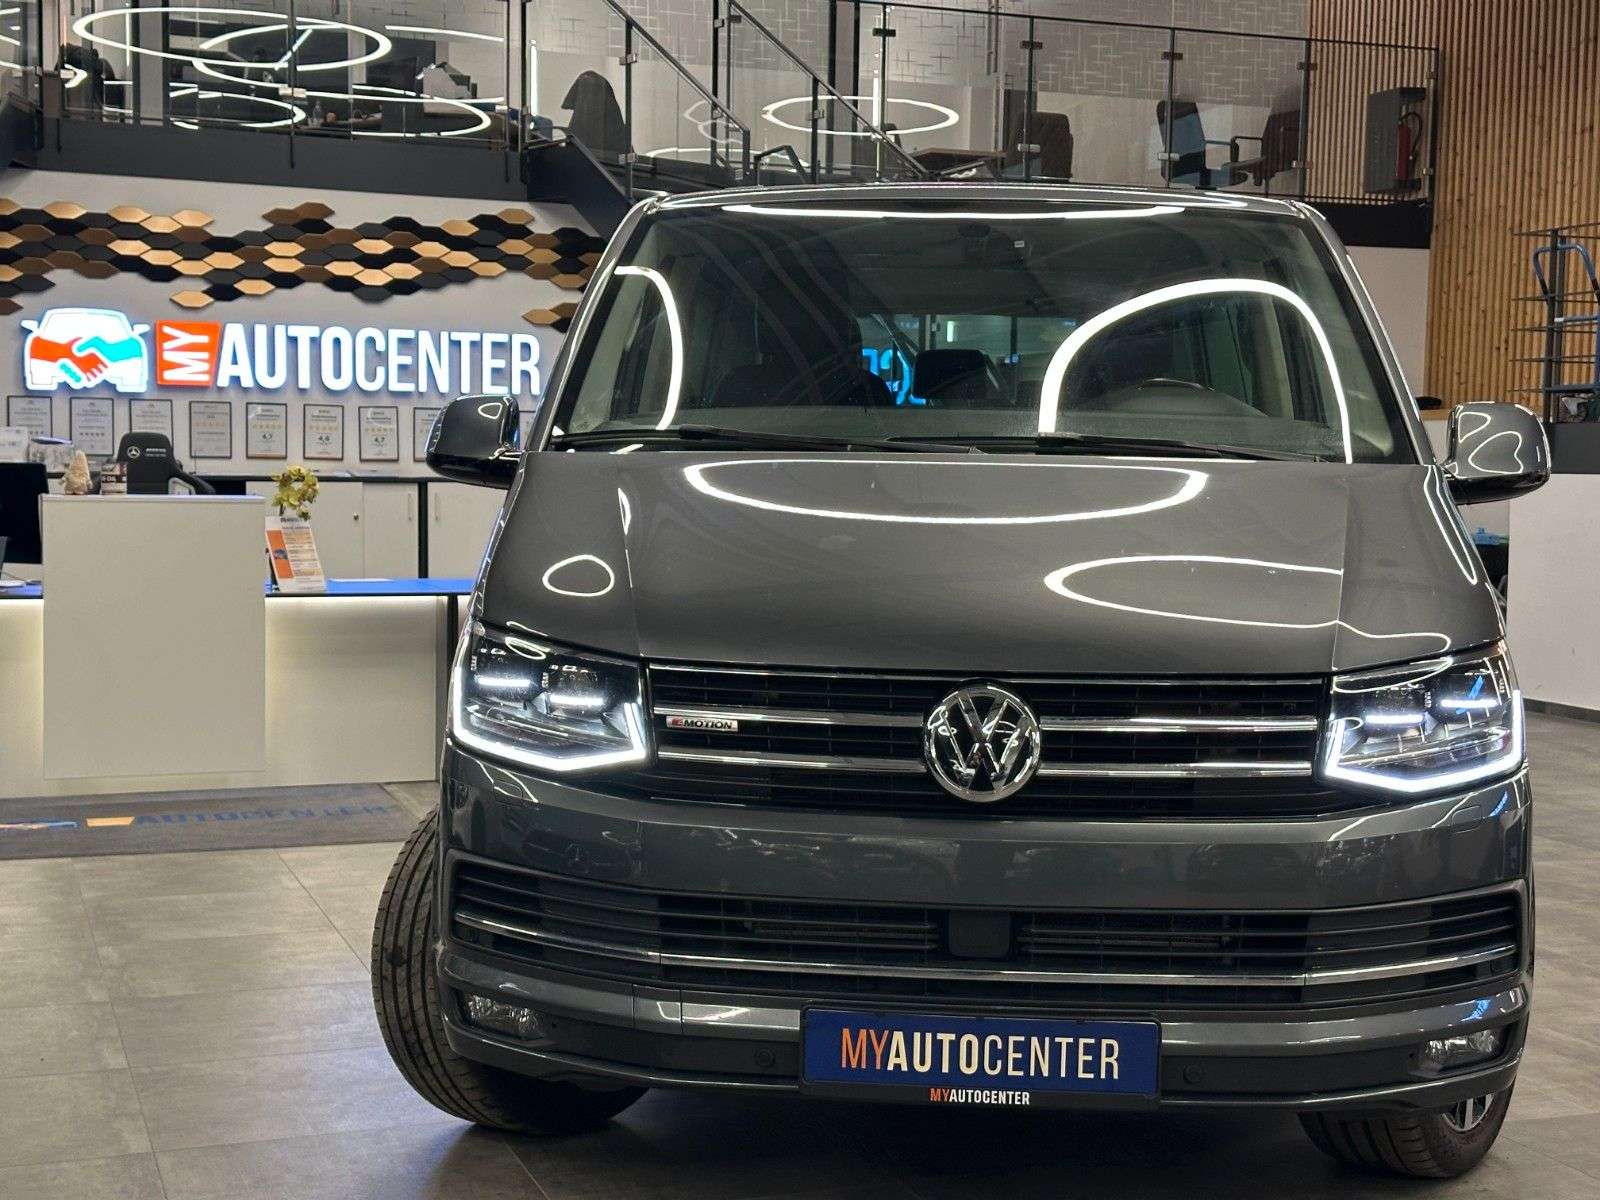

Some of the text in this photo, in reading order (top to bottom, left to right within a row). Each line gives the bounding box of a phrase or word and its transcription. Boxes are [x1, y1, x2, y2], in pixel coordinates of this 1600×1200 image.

[162, 322, 541, 395] MY AUTOCENTER
[839, 1027, 1120, 1080] MYAUTOCENTER
[929, 1087, 1031, 1105] MYAUTOCENTER
